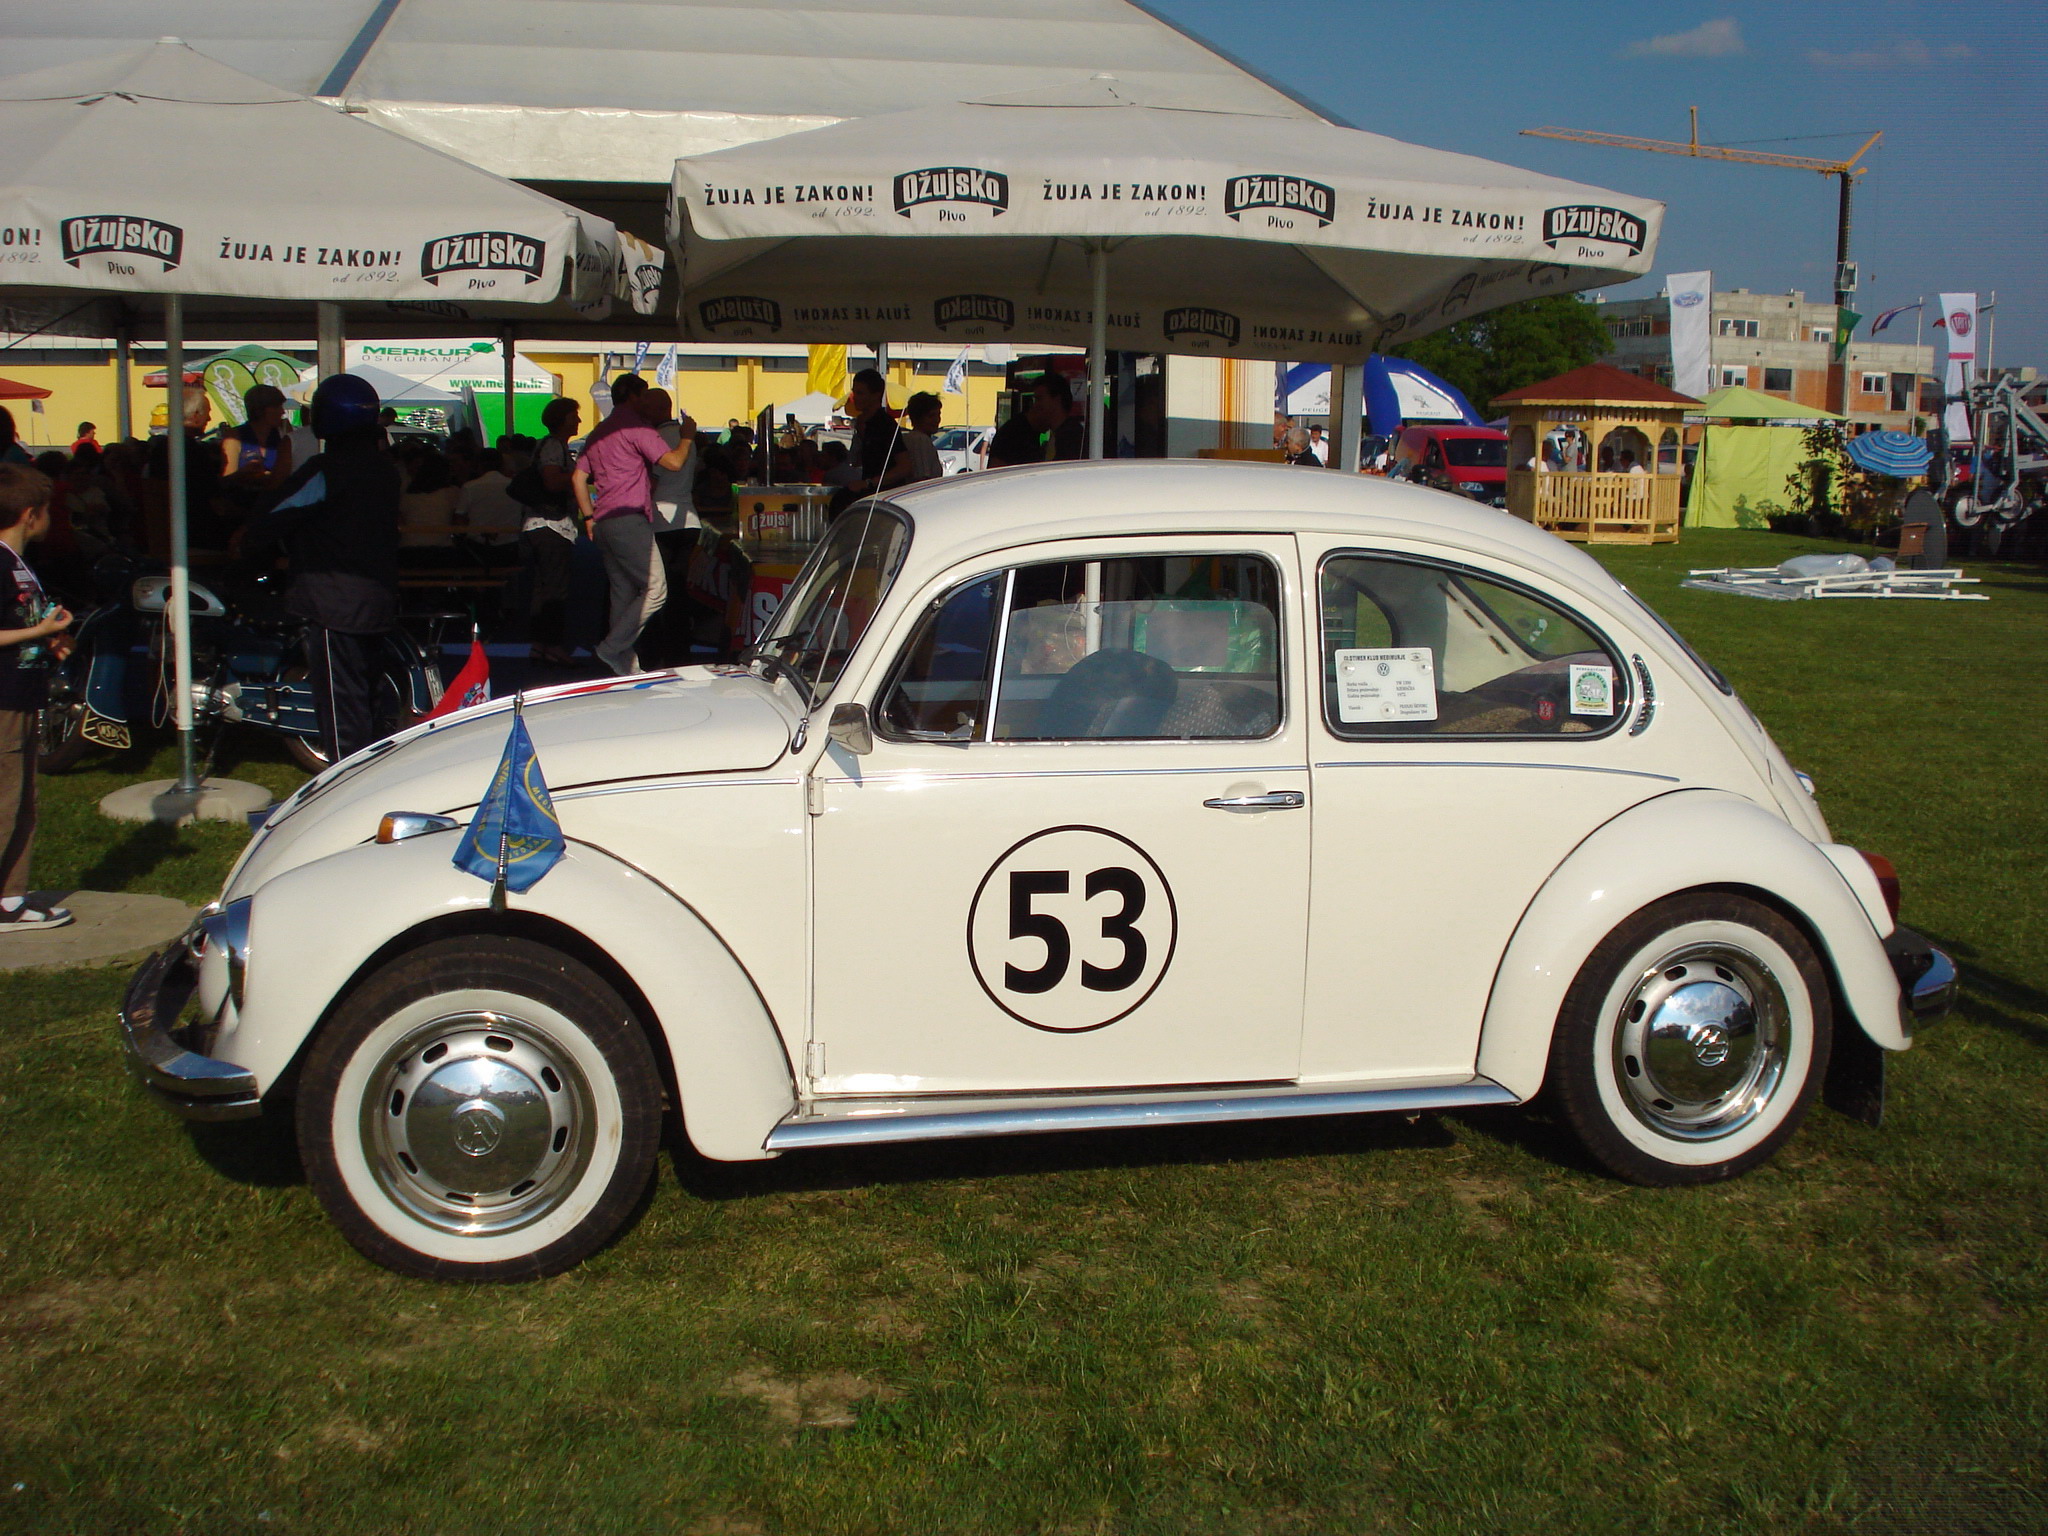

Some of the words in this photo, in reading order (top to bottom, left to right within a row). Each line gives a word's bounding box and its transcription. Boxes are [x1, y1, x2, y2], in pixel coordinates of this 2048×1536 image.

[704, 183, 755, 206] ŽUJA
[764, 186, 785, 205] JE
[795, 184, 874, 203] ZAKON!
[902, 168, 1000, 204] Ožujsko
[1043, 179, 1092, 201] ŽUJA
[1101, 183, 1121, 201] JE
[1131, 184, 1206, 201] ZAKON!
[1234, 176, 1328, 214] Ožujsko
[938, 209, 966, 222] Pivo
[1267, 215, 1294, 230] Pivo
[1367, 197, 1415, 221] ŽUJA
[1422, 207, 1443, 223] JE
[1451, 209, 1524, 231] ZAKON!
[1551, 205, 1639, 244] Ožujsko
[69, 217, 174, 256] Ožujsko
[219, 236, 274, 262] ŽUJA
[282, 246, 307, 264] JE
[317, 248, 402, 268] ZAKON!
[430, 232, 537, 270] Ožujsko
[107, 261, 136, 276] Pivo
[362, 345, 471, 356] MERKUR
[1005, 866, 1147, 994] 53
